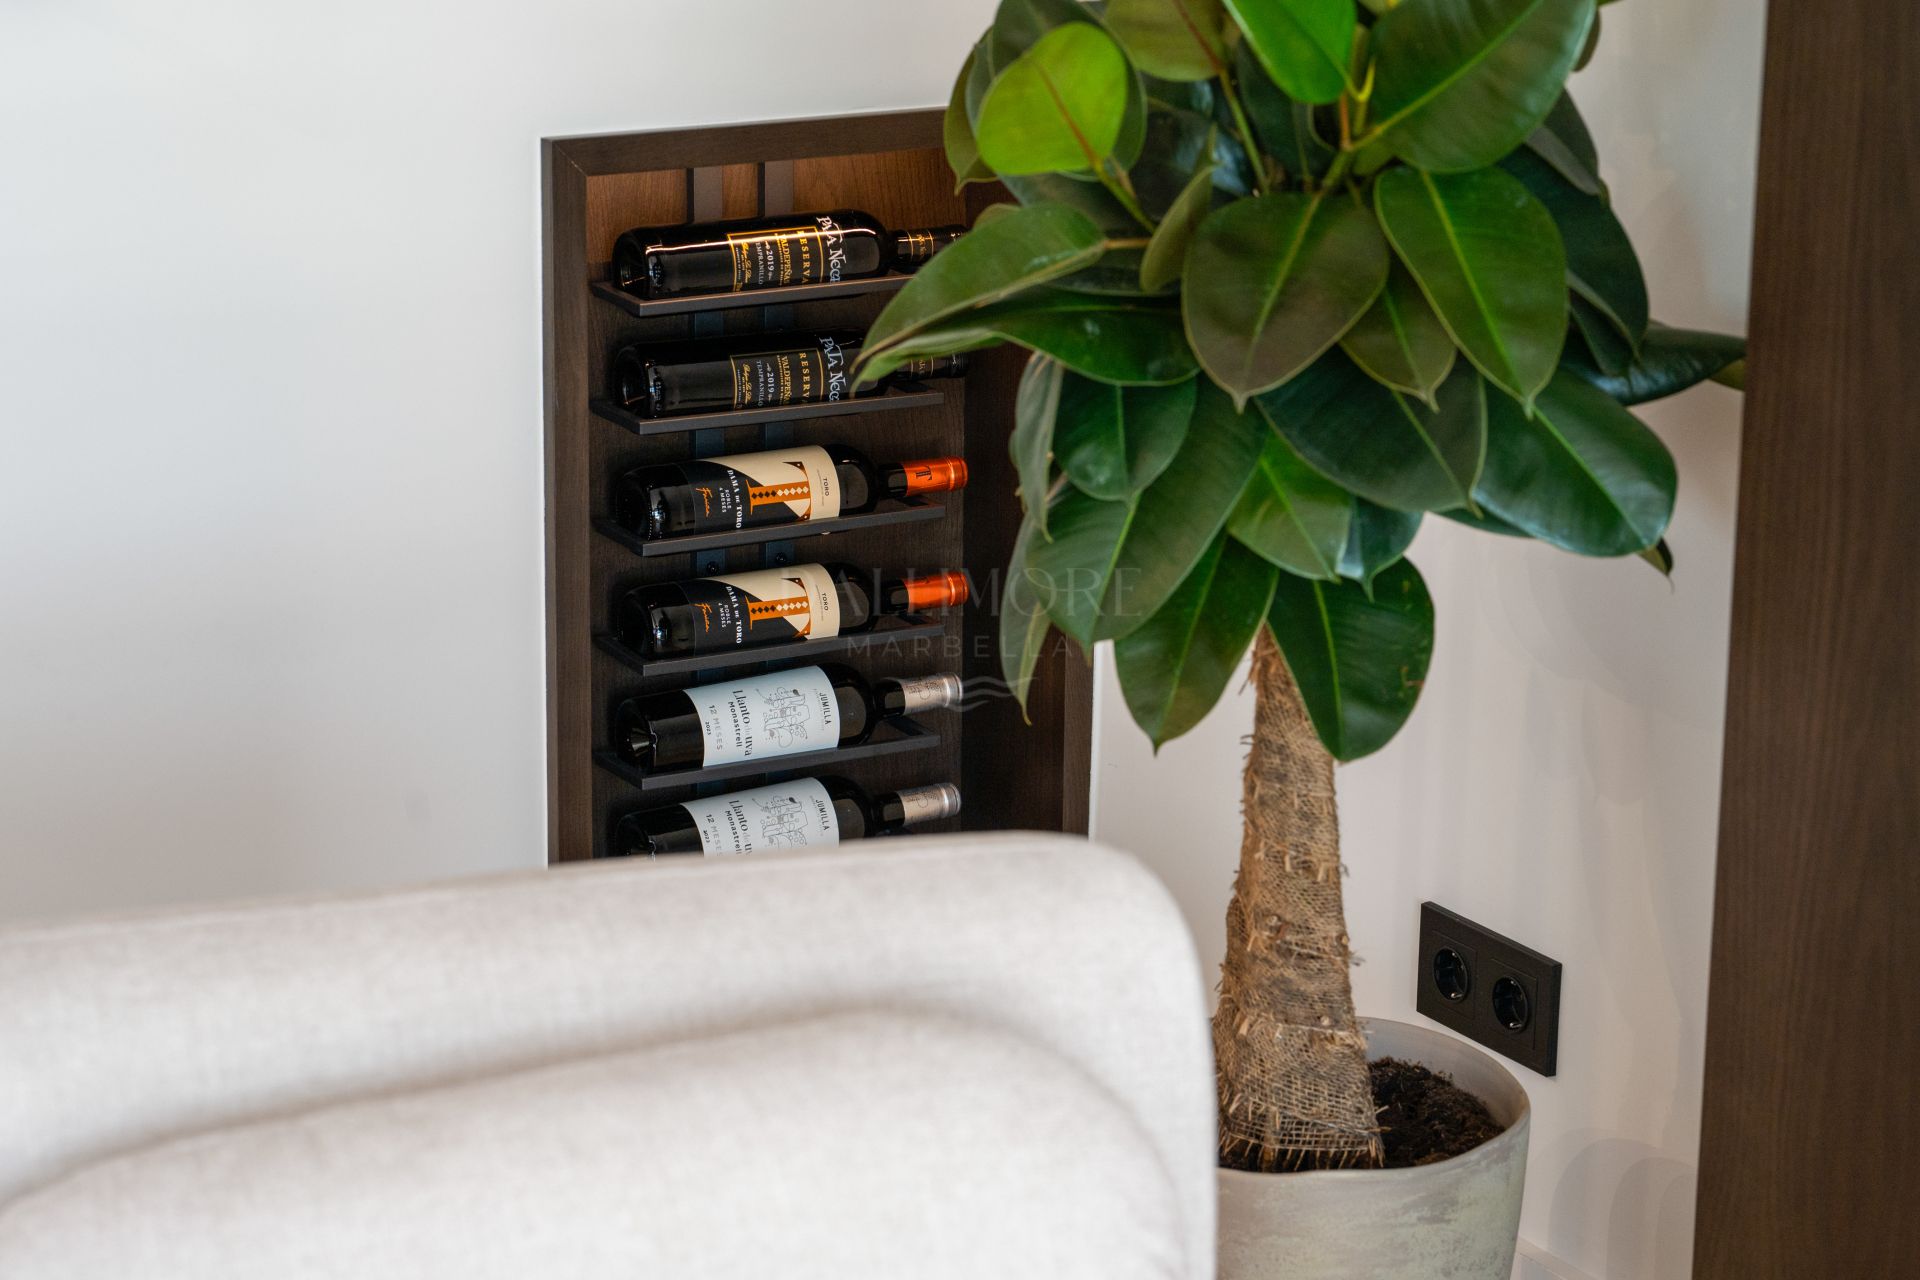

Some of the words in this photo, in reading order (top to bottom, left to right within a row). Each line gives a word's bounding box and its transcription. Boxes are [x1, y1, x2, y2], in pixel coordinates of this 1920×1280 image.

[765, 250, 775, 271] 2019
[818, 336, 844, 370] PATA
[767, 372, 775, 393] 2019
[798, 352, 811, 402] RESERV
[719, 492, 727, 513] MESES
[727, 469, 741, 493] DAMA
[735, 504, 743, 529] TORO
[822, 477, 830, 497] TORO
[719, 607, 727, 628] MESES
[726, 585, 740, 608] DAMA
[735, 619, 743, 644] TORO
[821, 592, 829, 611] TORO
[708, 704, 718, 716] 12
[727, 701, 743, 748] Monastrell
[732, 689, 752, 724] Llanto
[743, 735, 755, 757] uva
[819, 692, 832, 726] JUMILLA
[711, 717, 723, 751] MESES
[706, 813, 716, 824] 12
[728, 799, 750, 832] Llanto
[815, 799, 831, 831] JUMILLA
